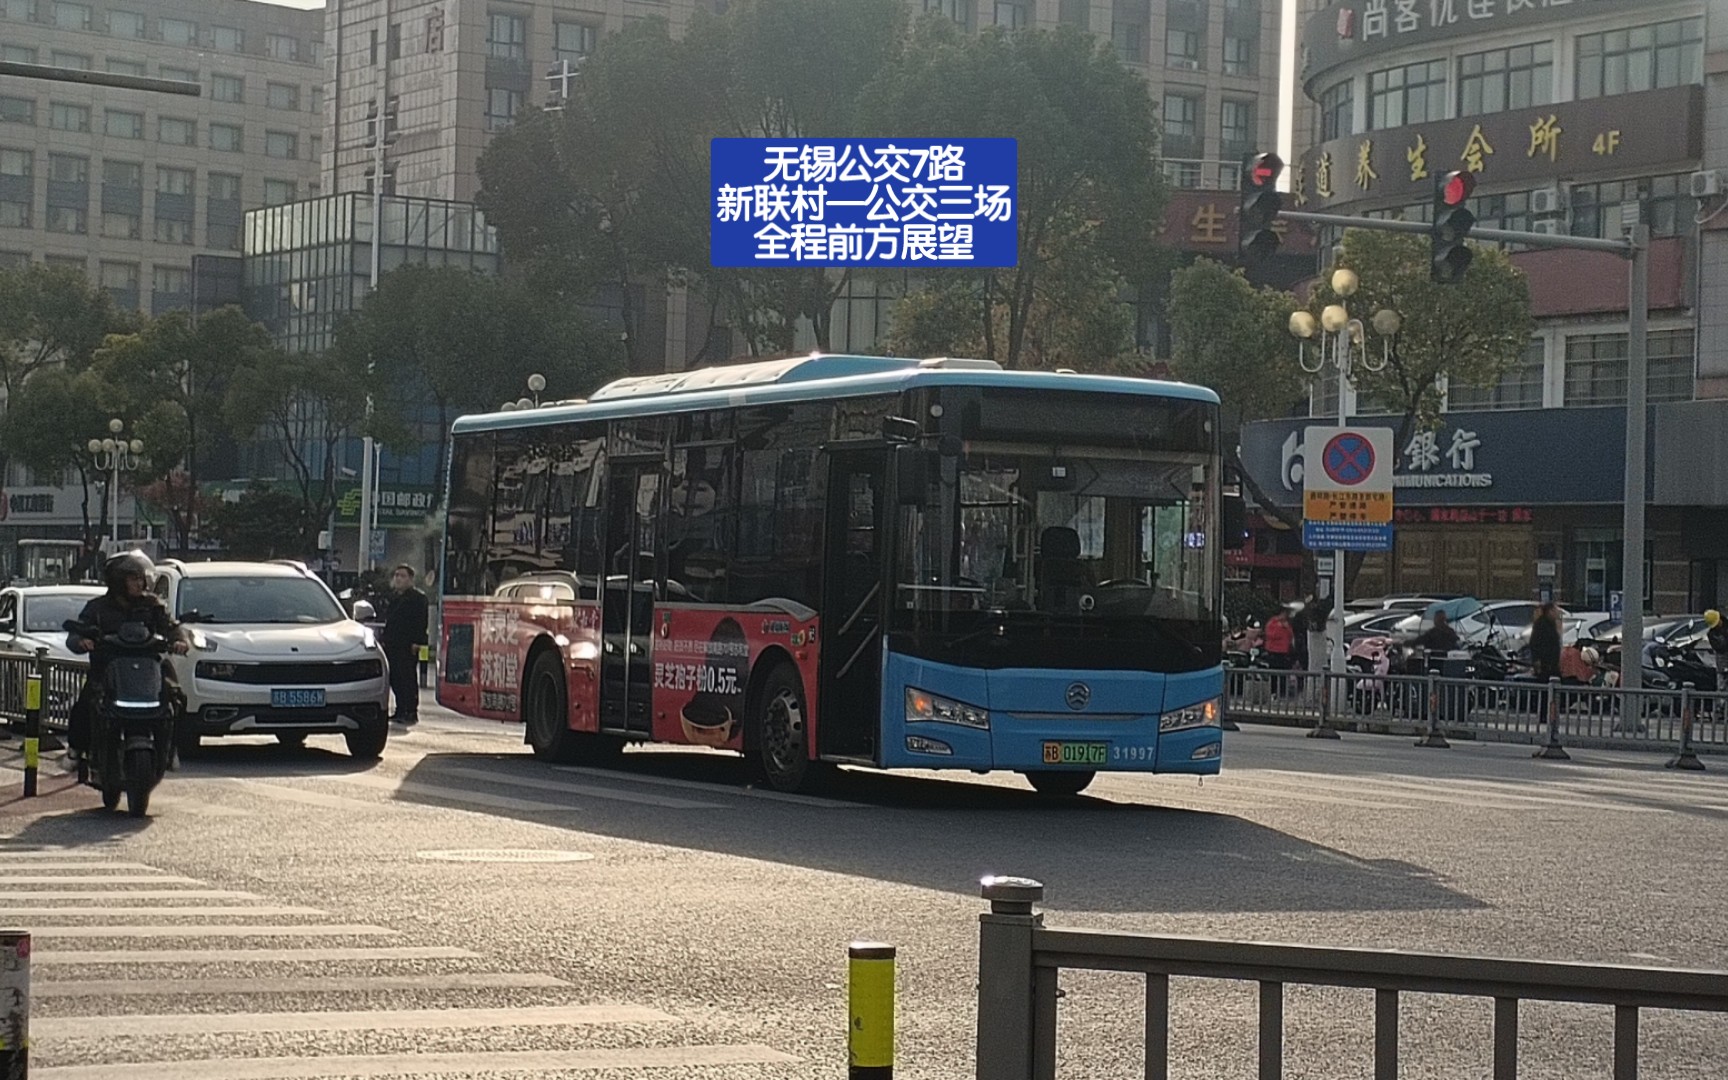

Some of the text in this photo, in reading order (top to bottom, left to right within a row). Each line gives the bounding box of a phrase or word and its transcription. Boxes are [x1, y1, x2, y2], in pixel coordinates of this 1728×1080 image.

[1362, 0, 1576, 41] 尚客优
[1592, 130, 1621, 156] 4F
[371, 490, 434, 508] 国邮政
[1610, 594, 1619, 609] P
[1113, 746, 1154, 760] 31997
